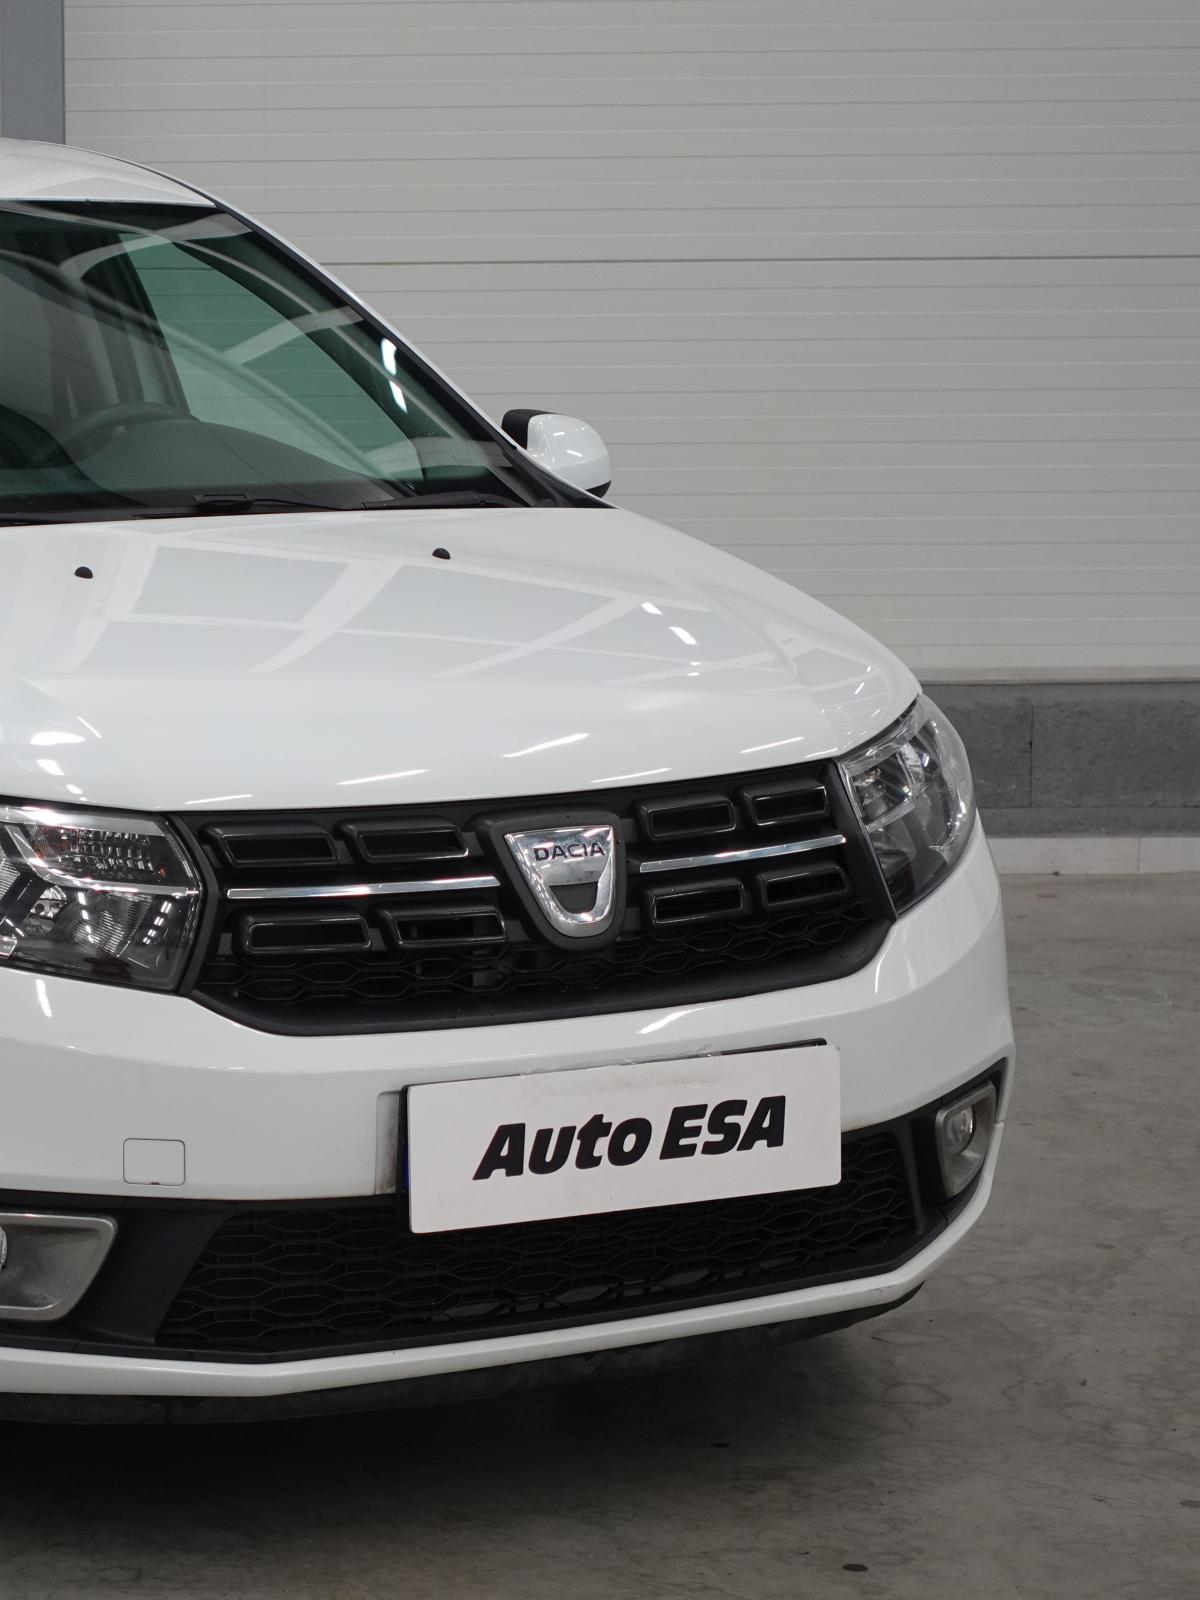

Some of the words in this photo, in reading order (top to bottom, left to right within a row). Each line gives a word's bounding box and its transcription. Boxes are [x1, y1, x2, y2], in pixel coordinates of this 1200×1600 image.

[534, 841, 605, 861] DACIA
[472, 1114, 652, 1180] Auto
[659, 1095, 786, 1160] ESA
